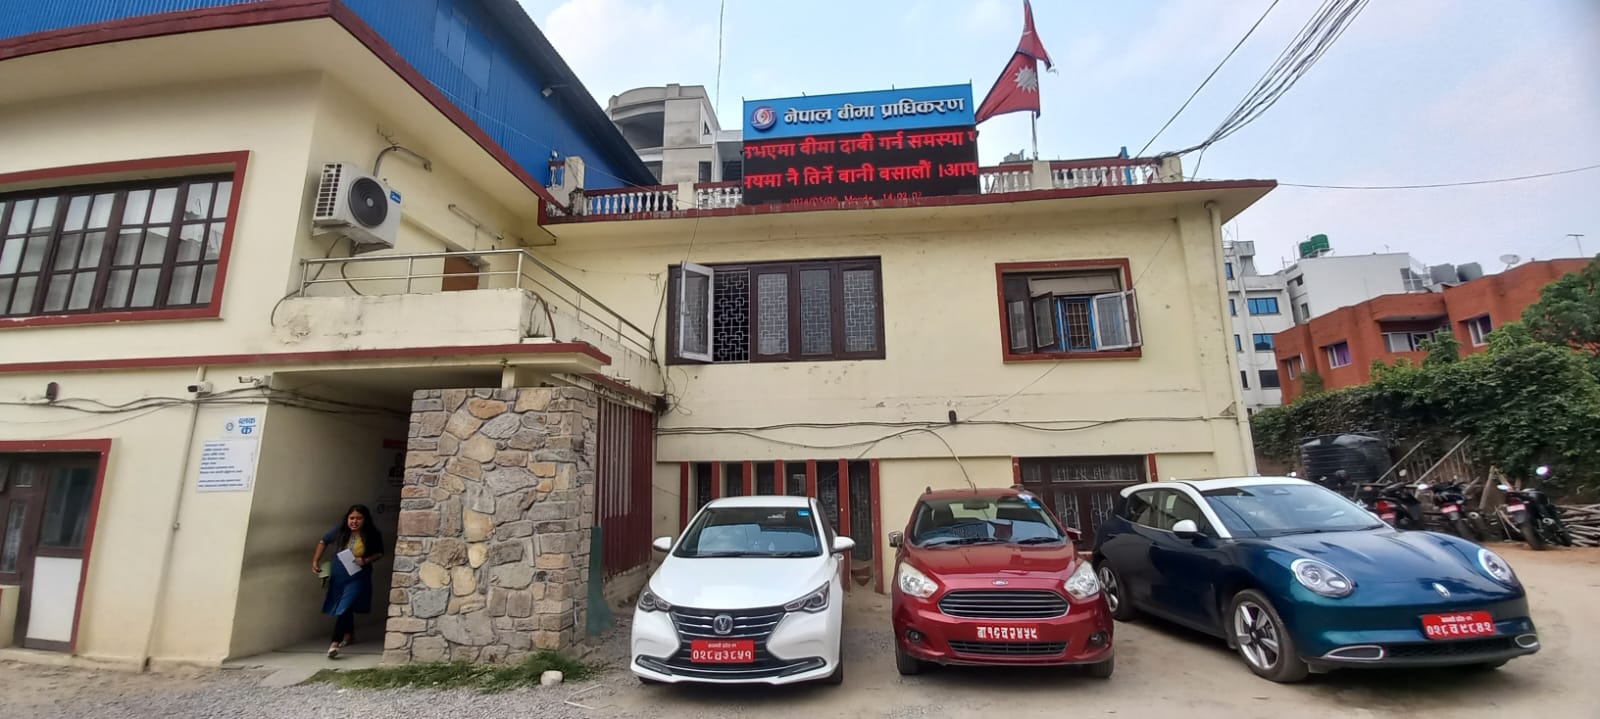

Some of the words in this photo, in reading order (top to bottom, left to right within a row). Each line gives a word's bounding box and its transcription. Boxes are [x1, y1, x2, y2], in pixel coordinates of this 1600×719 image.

[784, 107, 832, 123] नेपाल
[837, 103, 876, 119] बीमा
[880, 98, 965, 119] प्राधिकरण
[798, 135, 835, 155] बीमा
[838, 132, 874, 154] दाबी
[878, 130, 904, 150] गर्न
[907, 131, 964, 149] समस्या
[785, 167, 799, 186] नै
[837, 162, 874, 184] बानी
